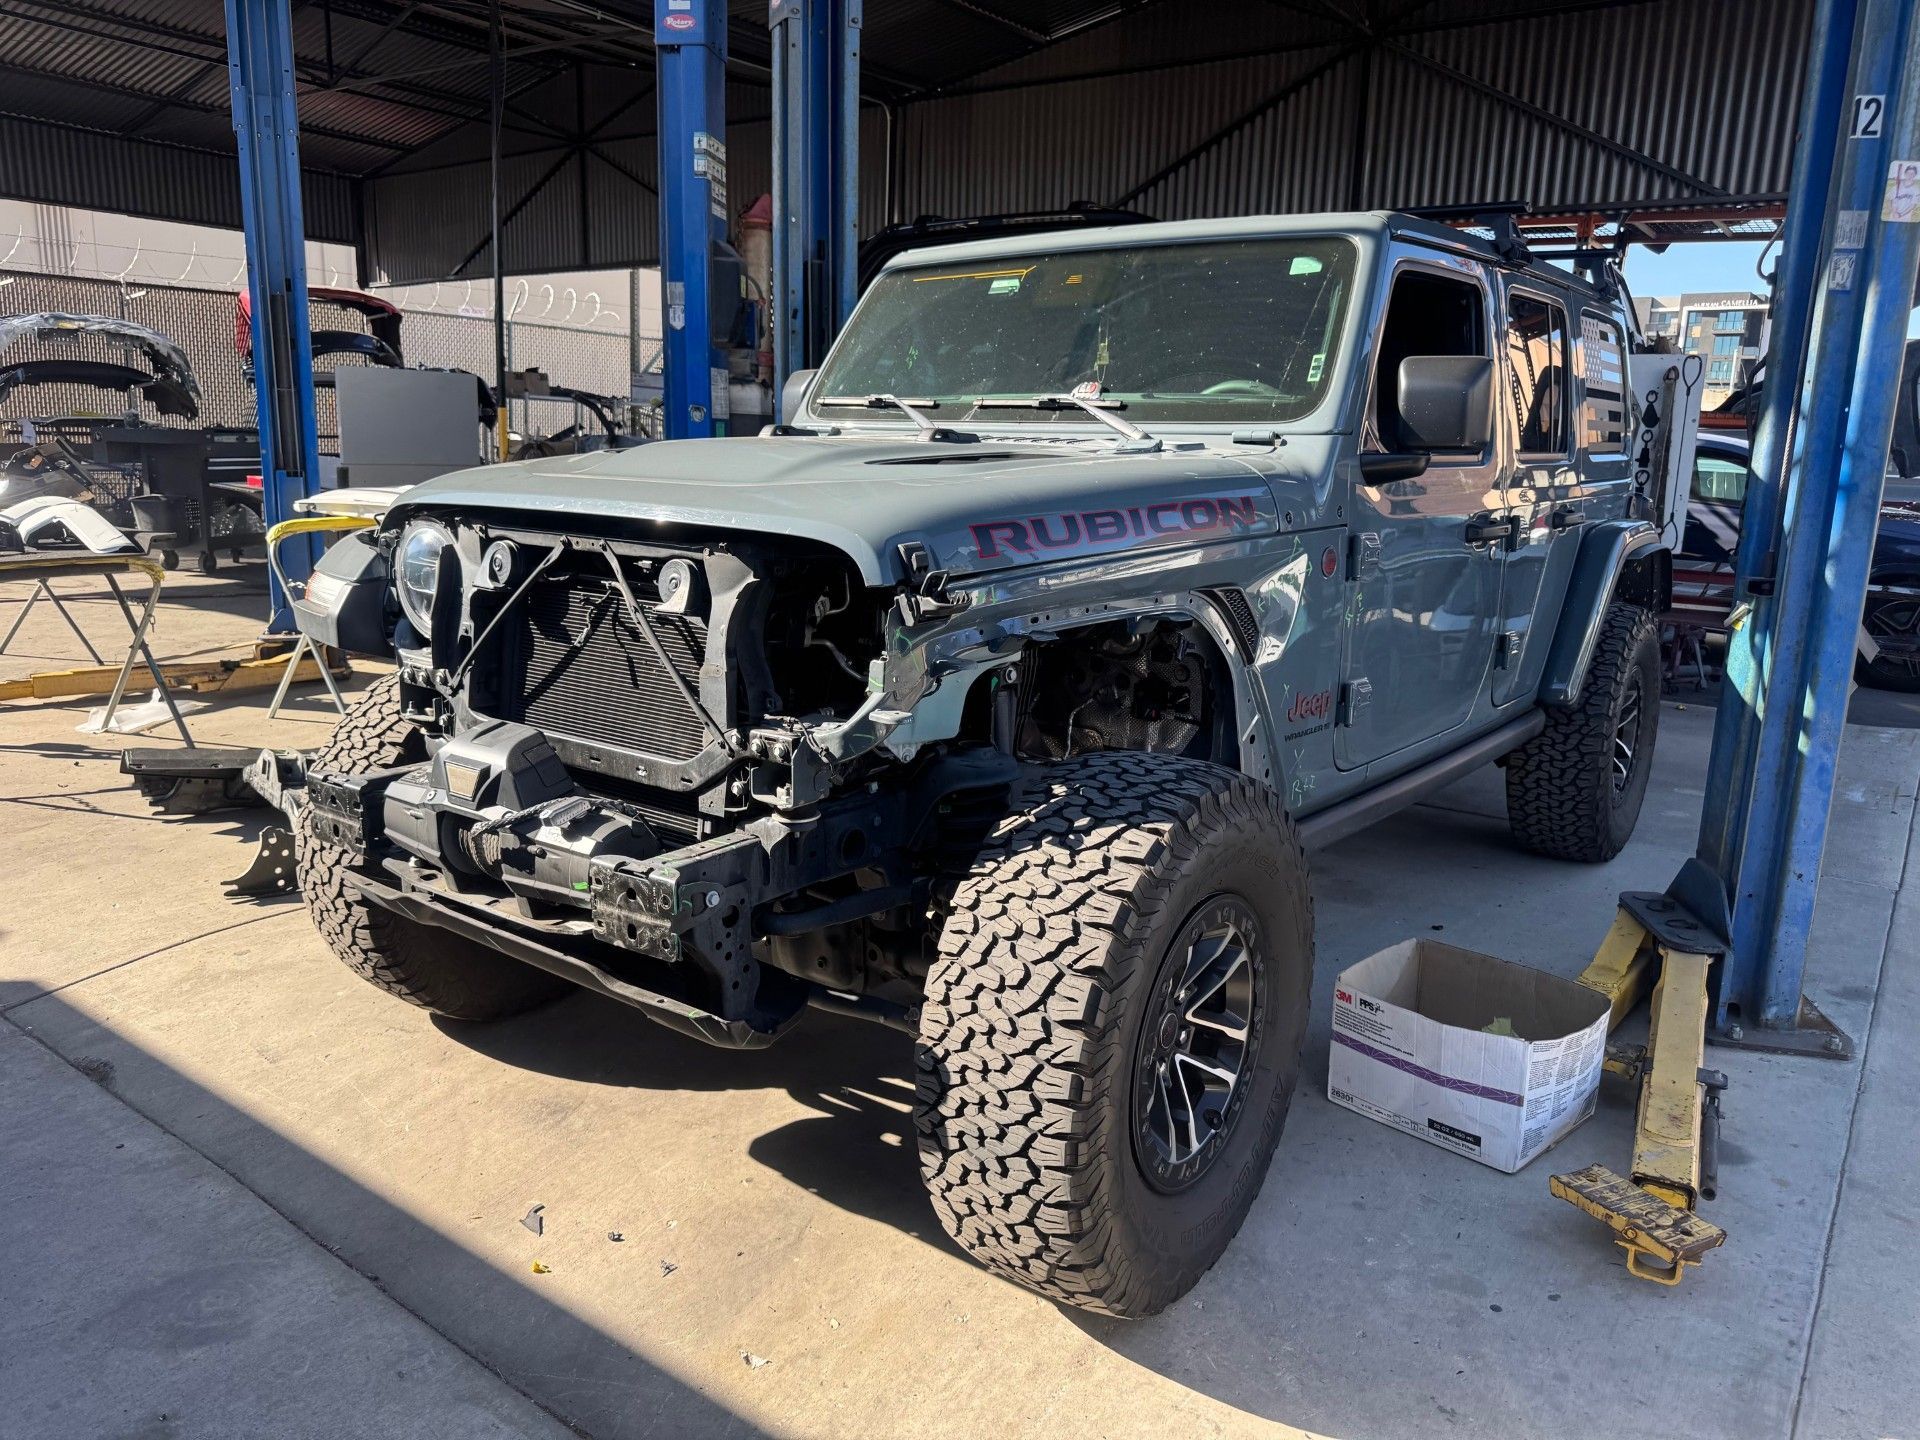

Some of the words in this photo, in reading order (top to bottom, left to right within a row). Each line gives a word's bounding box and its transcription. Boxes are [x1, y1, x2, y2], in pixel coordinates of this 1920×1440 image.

[1851, 97, 1881, 136] 12
[1721, 299, 1758, 307] CAMELLIA
[968, 496, 1258, 559] RUBICON
[1288, 690, 1330, 722] Jeep
[1284, 723, 1323, 742] WRANGLER
[1336, 988, 1352, 1004] 3M
[1360, 998, 1374, 1012] PPS
[1331, 1088, 1354, 1103] 26301
